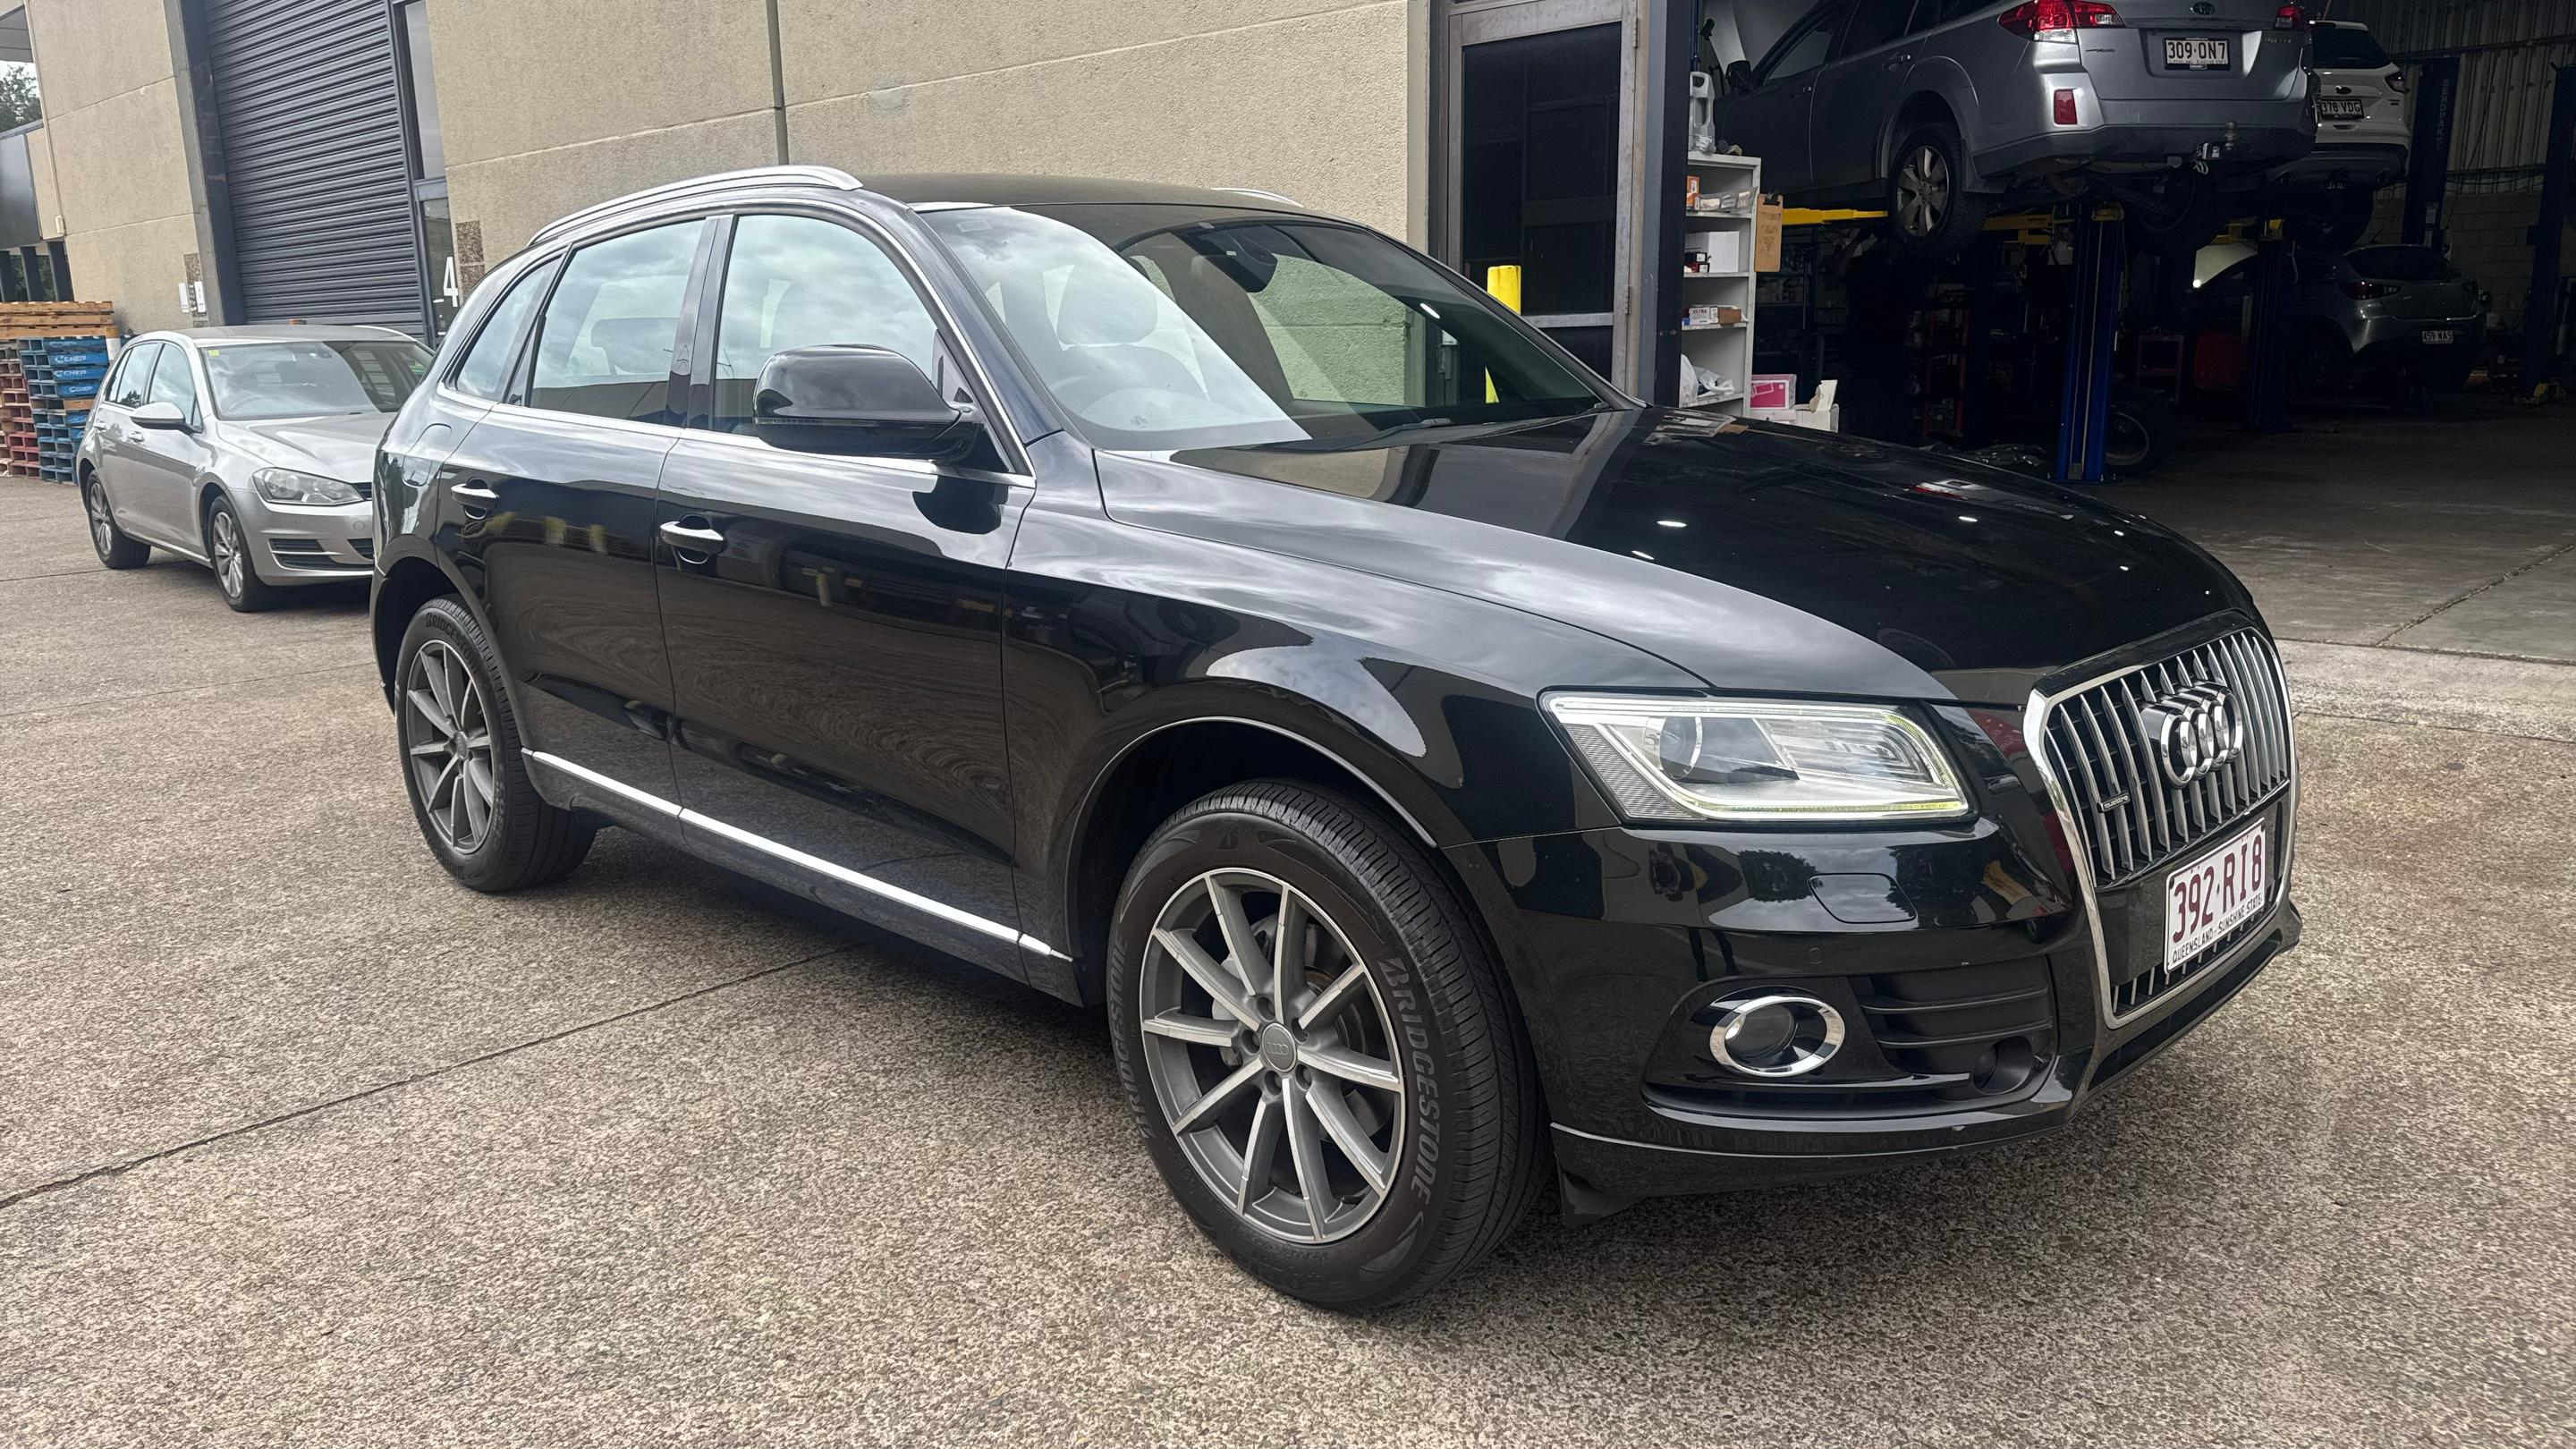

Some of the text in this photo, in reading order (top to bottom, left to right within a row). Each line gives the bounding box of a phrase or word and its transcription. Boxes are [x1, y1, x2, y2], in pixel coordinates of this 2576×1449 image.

[443, 256, 459, 308] 4
[2172, 927, 2214, 962] QUEENSLAND
[2218, 908, 2245, 935] SUNSHINE
[2246, 894, 2262, 914] STATE
[1378, 956, 1441, 1206] BRIDGESTONE
